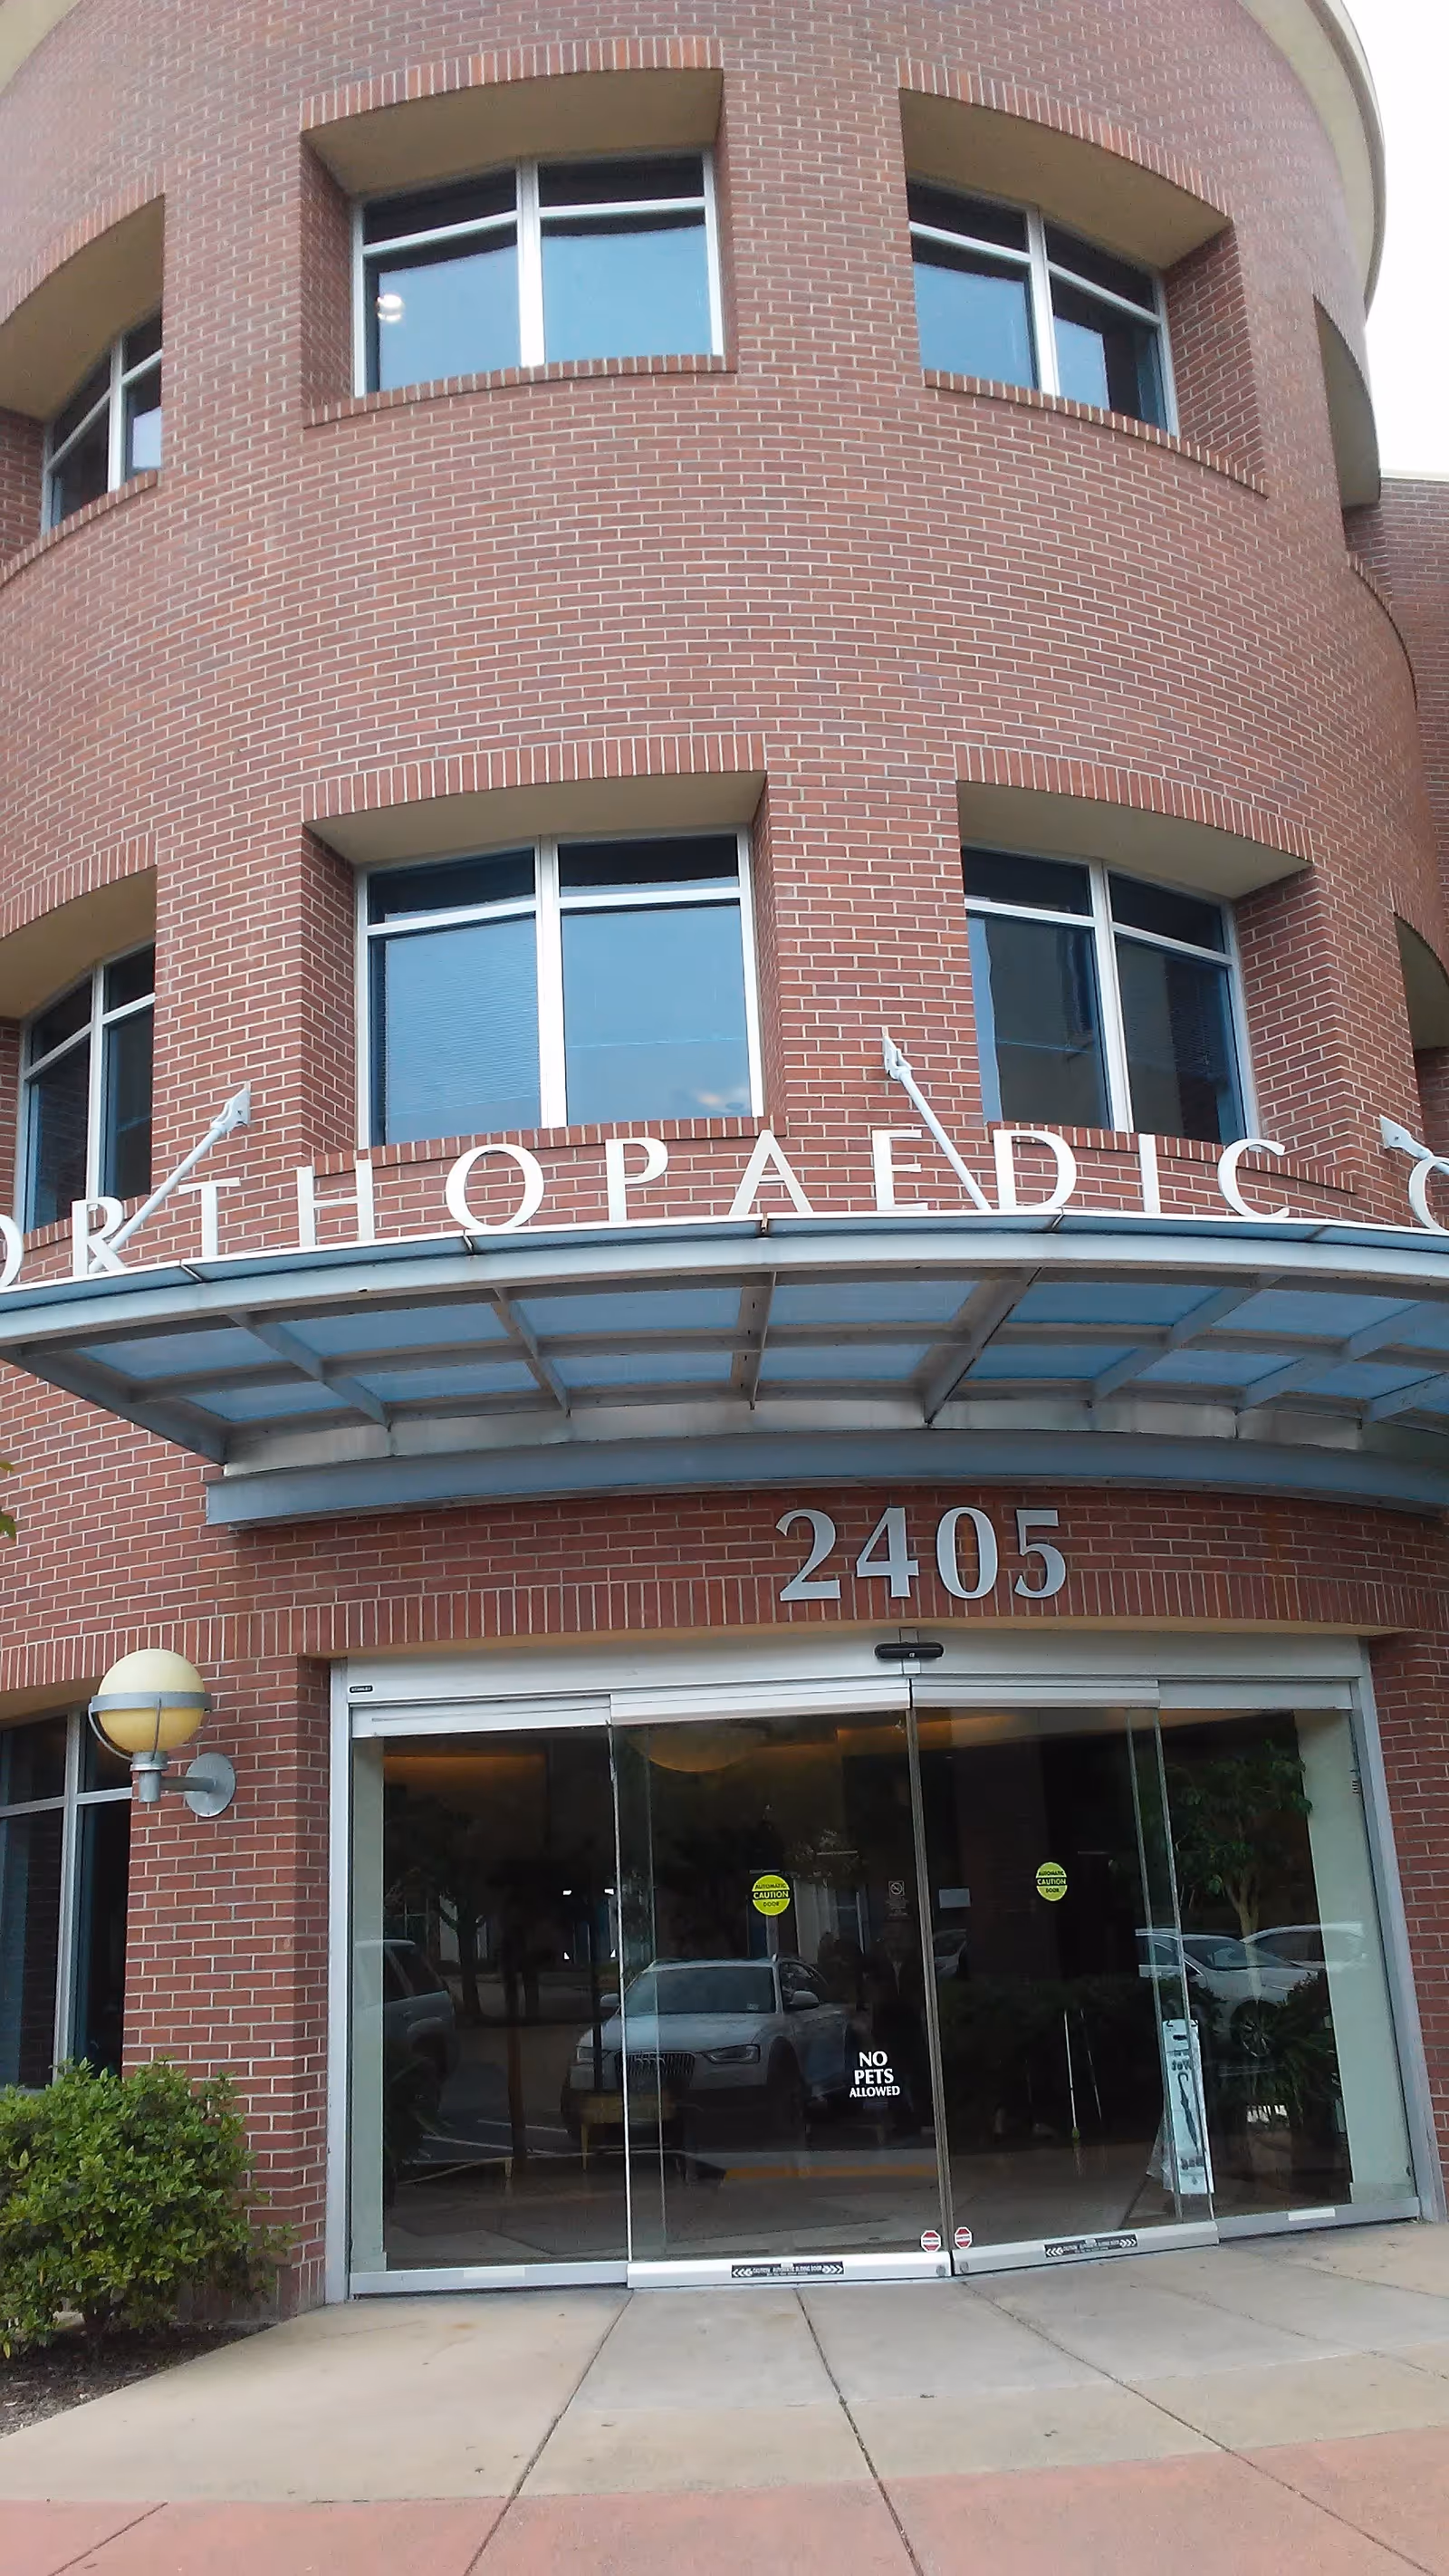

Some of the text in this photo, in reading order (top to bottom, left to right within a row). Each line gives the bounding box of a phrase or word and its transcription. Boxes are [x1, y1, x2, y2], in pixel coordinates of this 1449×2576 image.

[0, 1129, 1289, 1287] RTHOPAEDIC
[775, 1506, 1066, 1601] 2405
[753, 1890, 789, 1899] CAUTION
[859, 2051, 888, 2067] NO
[854, 2068, 895, 2085] PETS
[849, 2085, 901, 2098] ALLOWED
